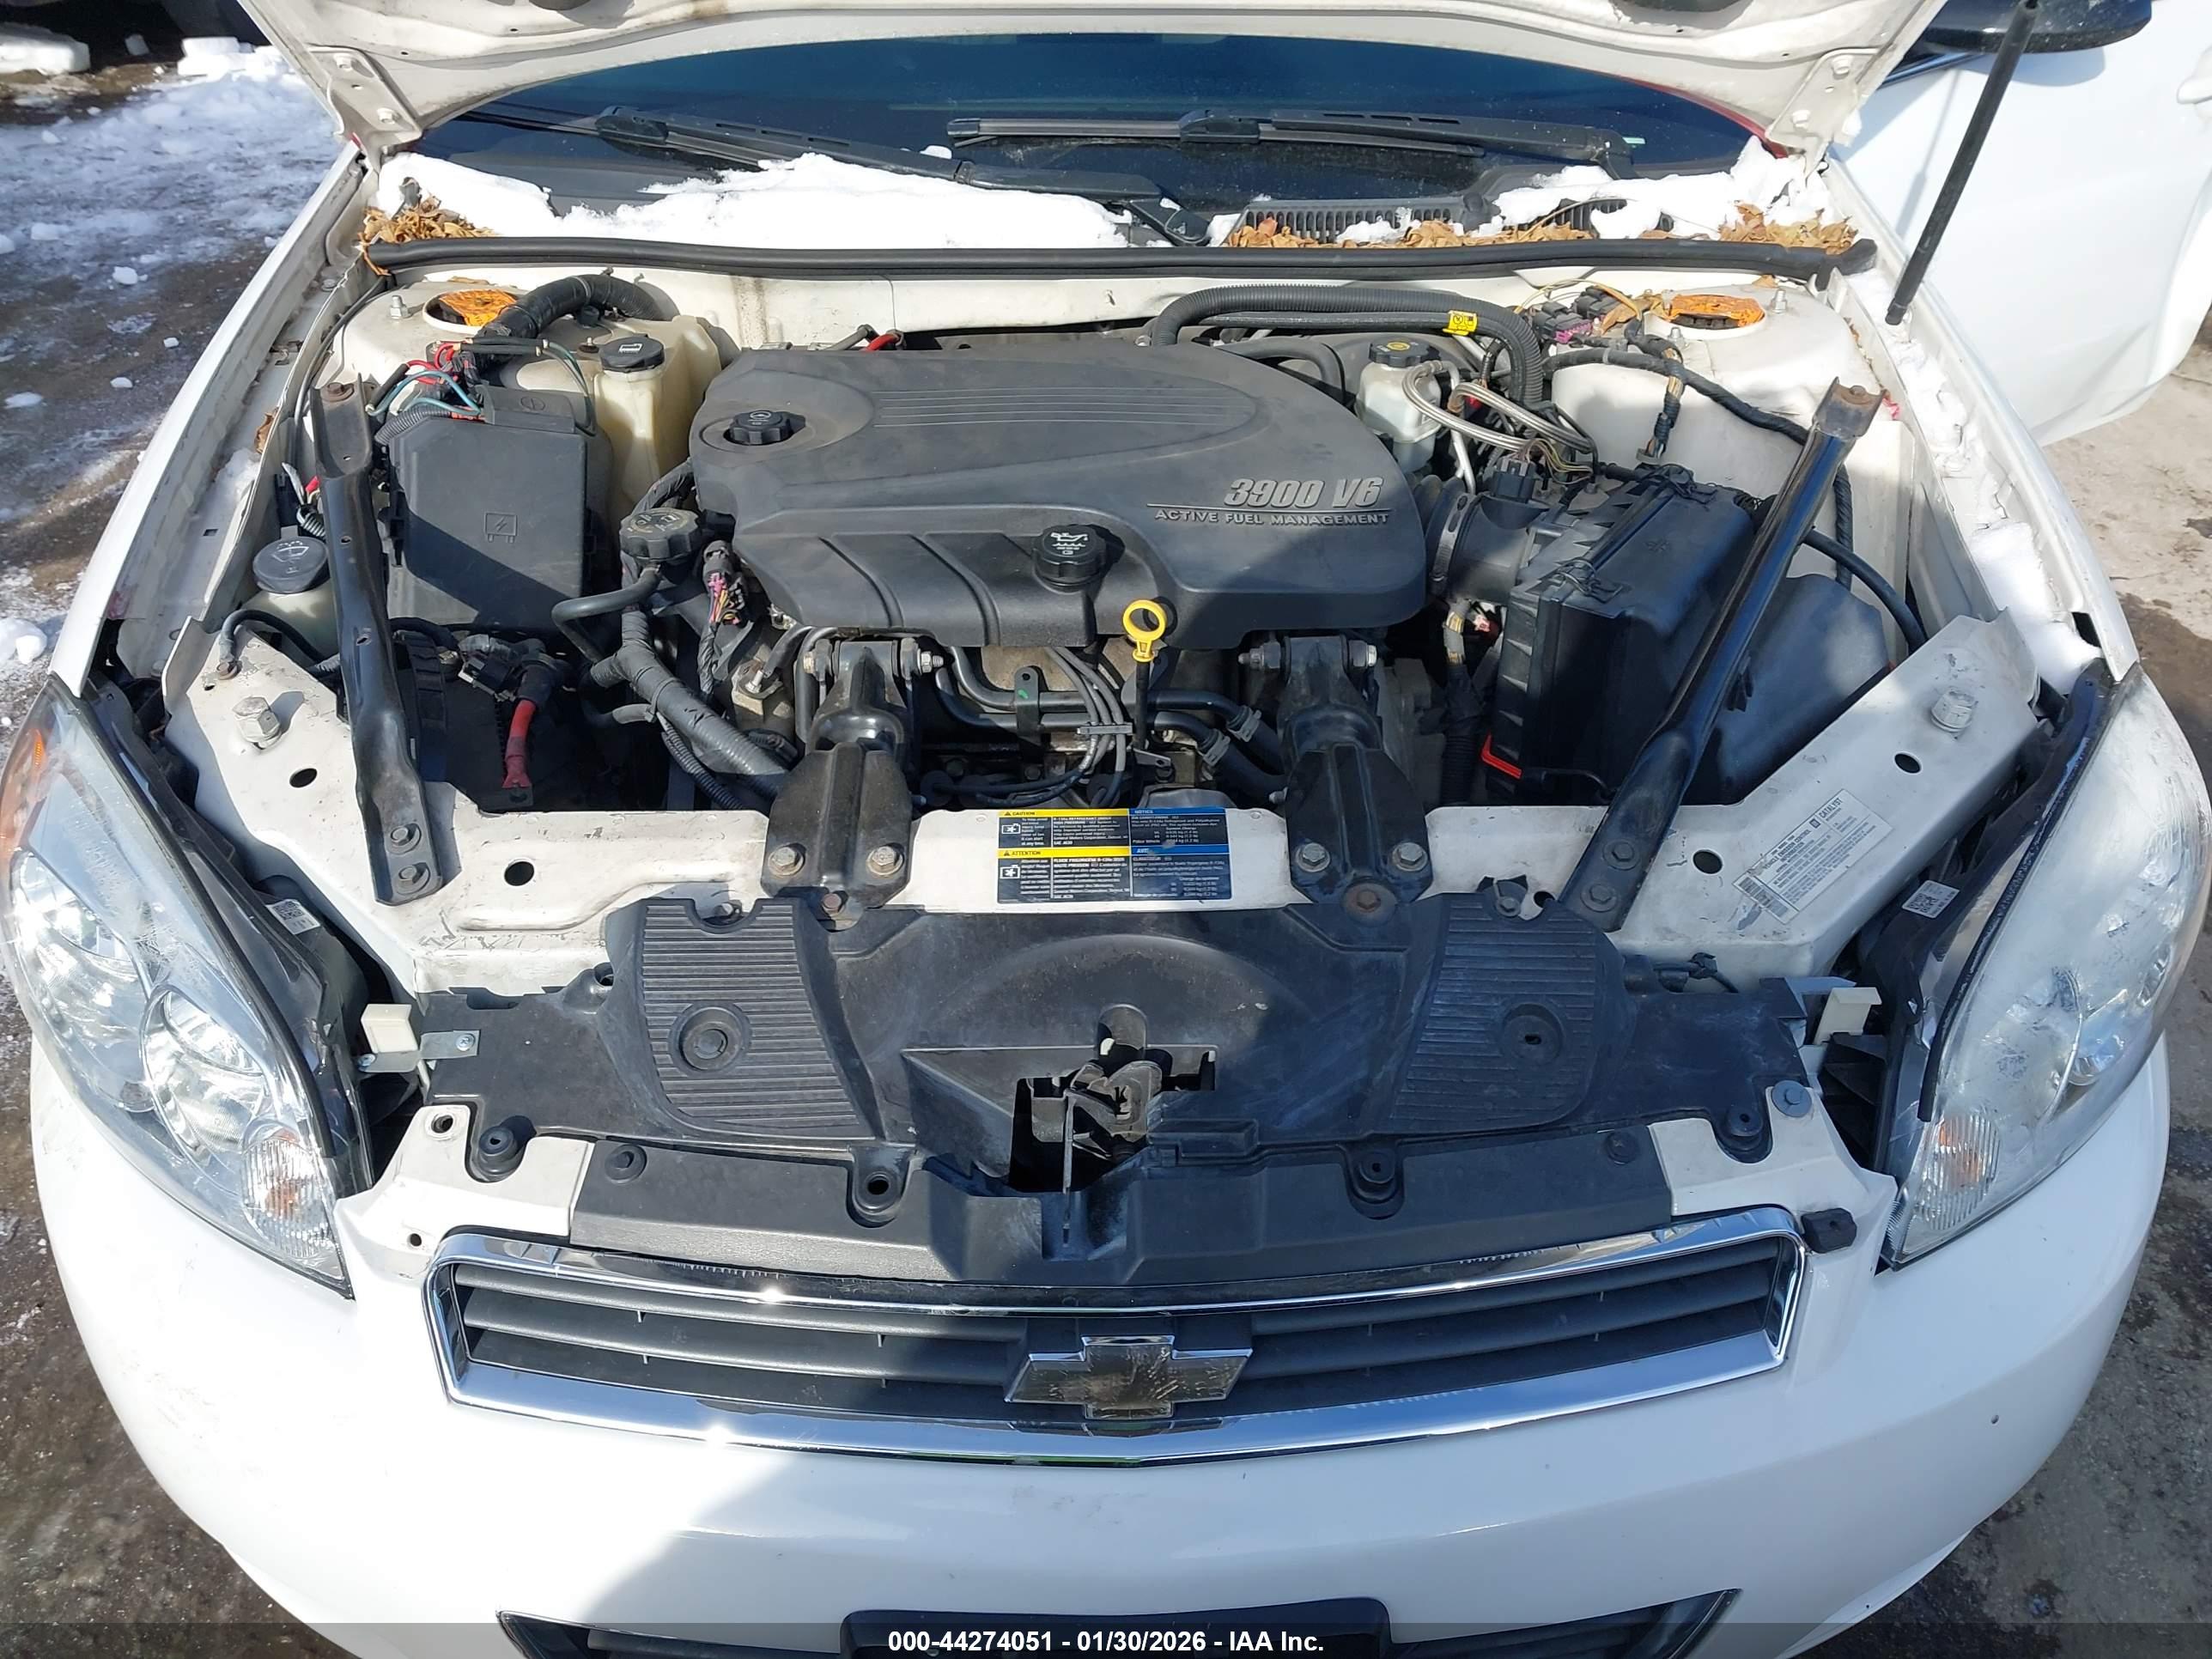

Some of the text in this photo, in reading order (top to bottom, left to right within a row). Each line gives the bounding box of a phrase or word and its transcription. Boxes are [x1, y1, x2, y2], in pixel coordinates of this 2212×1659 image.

[1224, 477, 1383, 508] 3900 V6
[1154, 509, 1389, 526] ACTIVE FUEL MANAGEMENT
[1819, 798, 1844, 818] CATALYST
